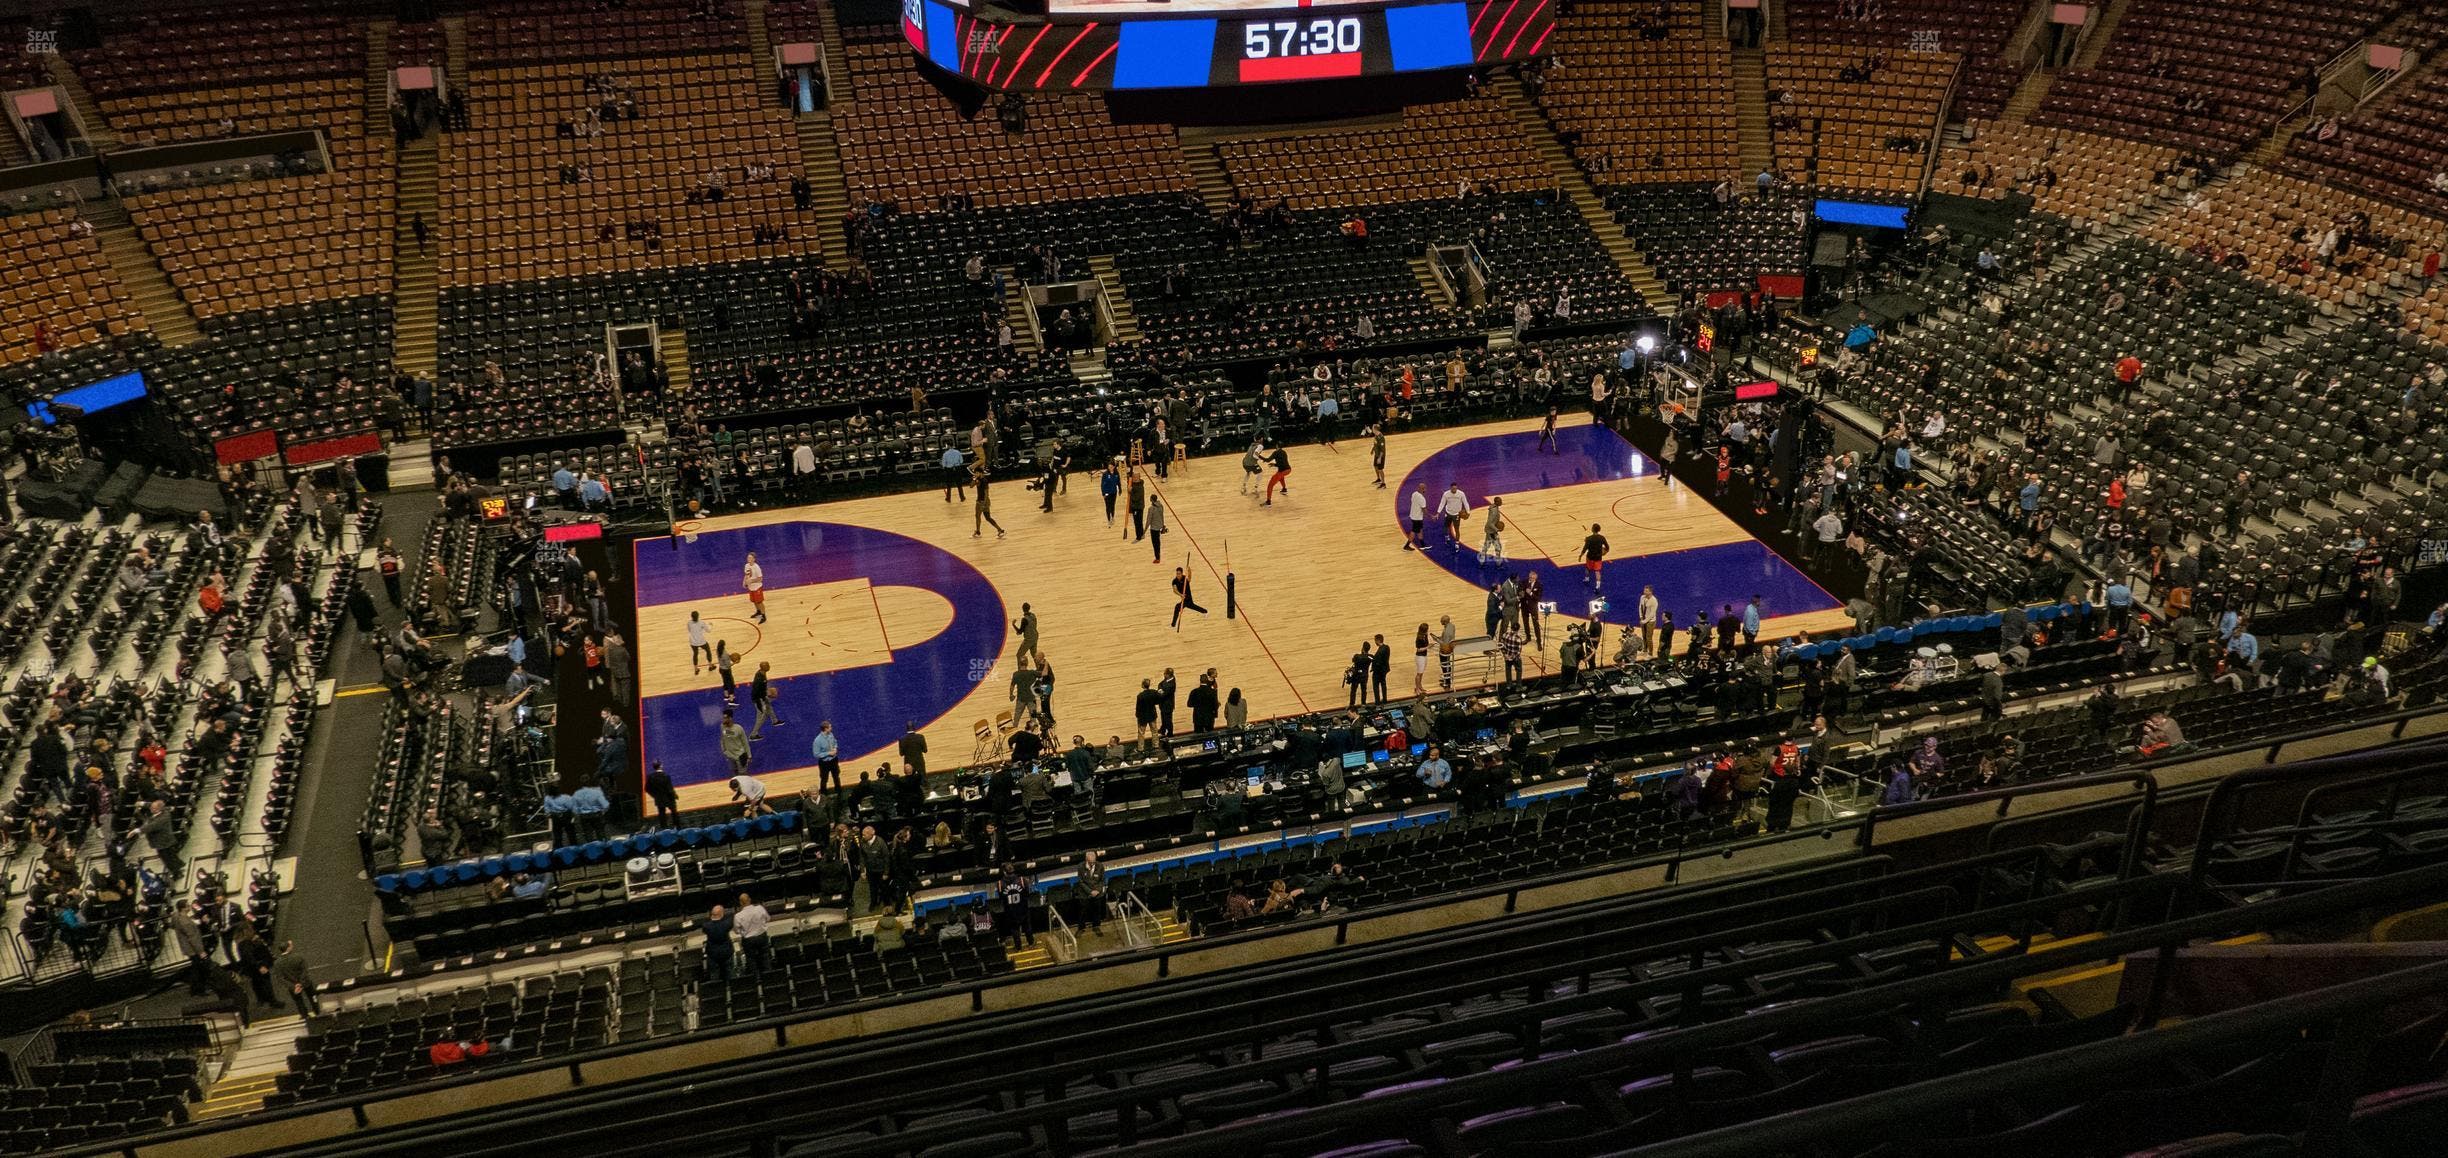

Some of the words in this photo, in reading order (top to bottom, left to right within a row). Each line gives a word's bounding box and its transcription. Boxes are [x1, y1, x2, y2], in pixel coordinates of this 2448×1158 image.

[1246, 18, 1361, 59] 57:30
[1698, 334, 1711, 352] 24
[482, 499, 505, 509] 57:30
[487, 507, 502, 517] 24
[1725, 661, 1732, 672] 2
[1007, 893, 1021, 905] 10
